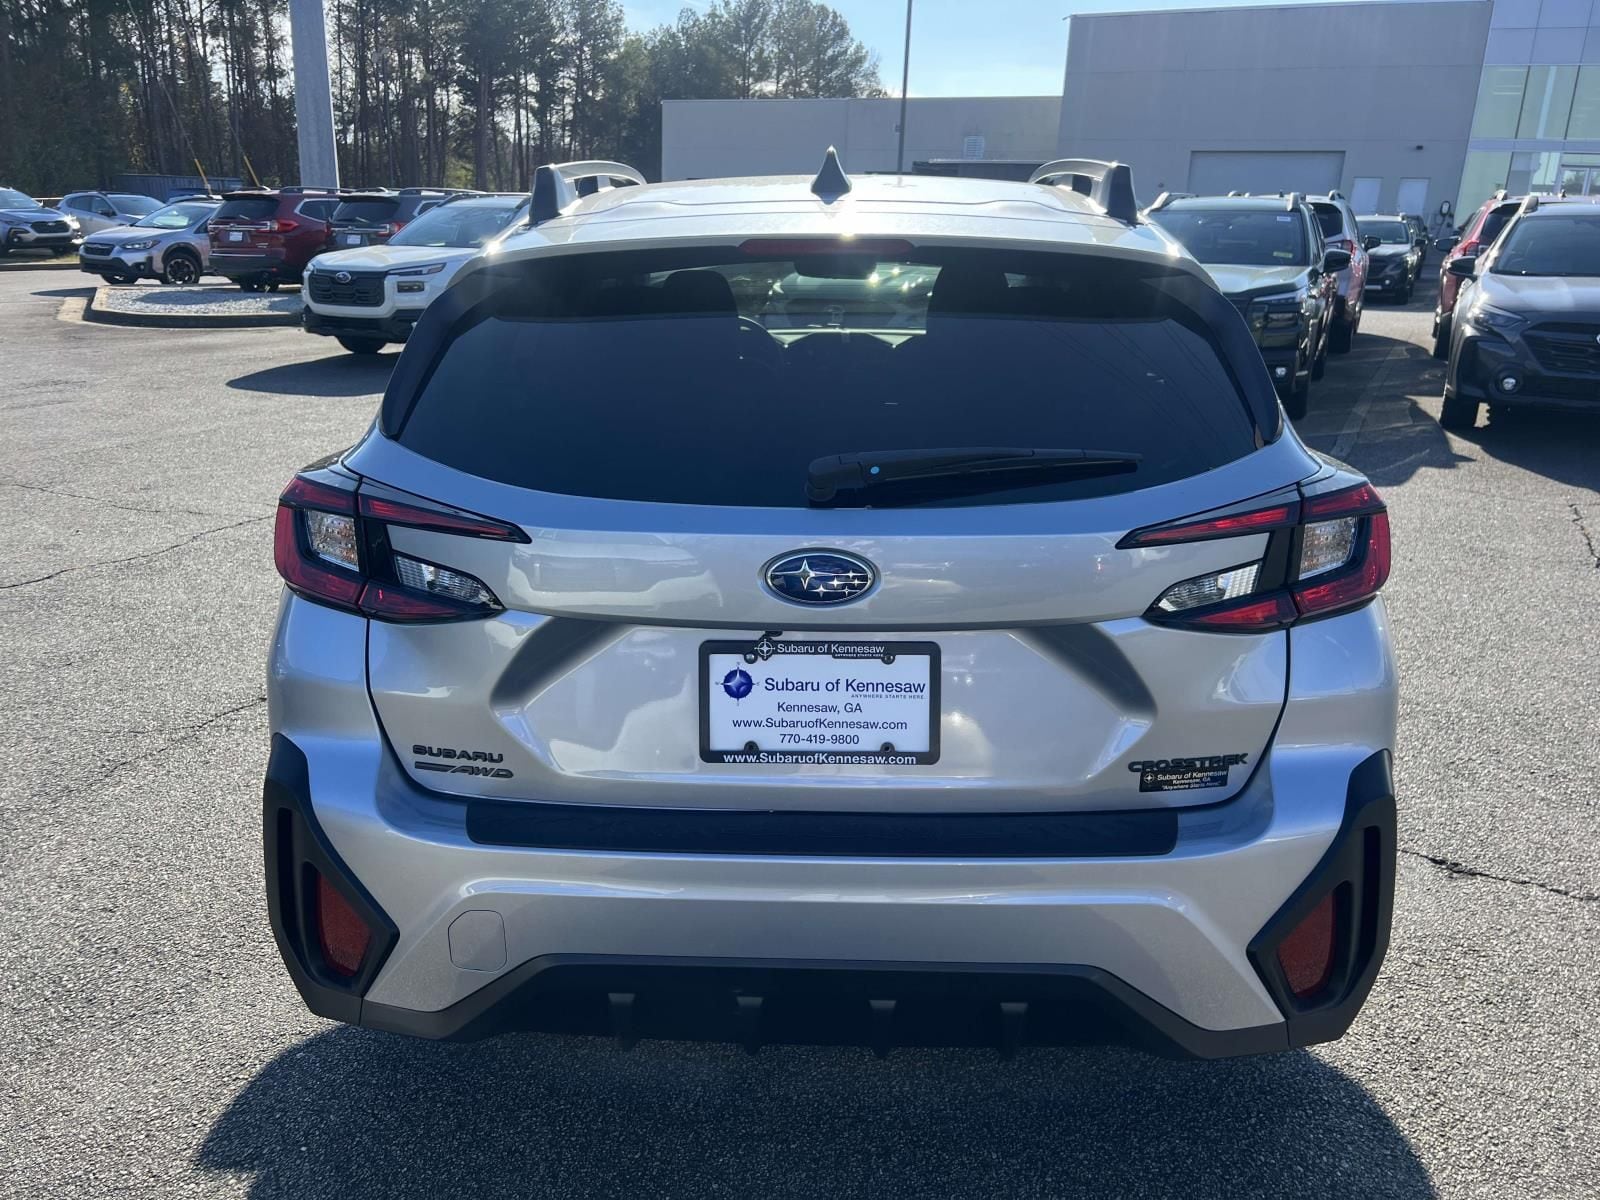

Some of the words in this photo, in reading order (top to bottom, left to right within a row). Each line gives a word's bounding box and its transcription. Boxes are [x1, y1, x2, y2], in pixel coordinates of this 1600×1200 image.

[777, 643, 815, 653] Subaru
[817, 643, 829, 653] of
[831, 643, 885, 654] Kennesaw
[764, 677, 820, 692] Subaru
[825, 678, 841, 692] of
[845, 678, 926, 693] Kennesaw
[777, 702, 840, 715] Kennesaw,
[844, 702, 863, 713] GA
[732, 717, 908, 730] www.SubaruofKennesaw.com
[779, 733, 860, 745] 770-419-9800
[412, 744, 504, 764] SUBARU
[723, 752, 917, 765] www.SubaruofKennesaw.com
[1127, 753, 1249, 772] CROSSTREK
[450, 765, 514, 779] AWD
[1192, 770, 1227, 778] Kennesaw
